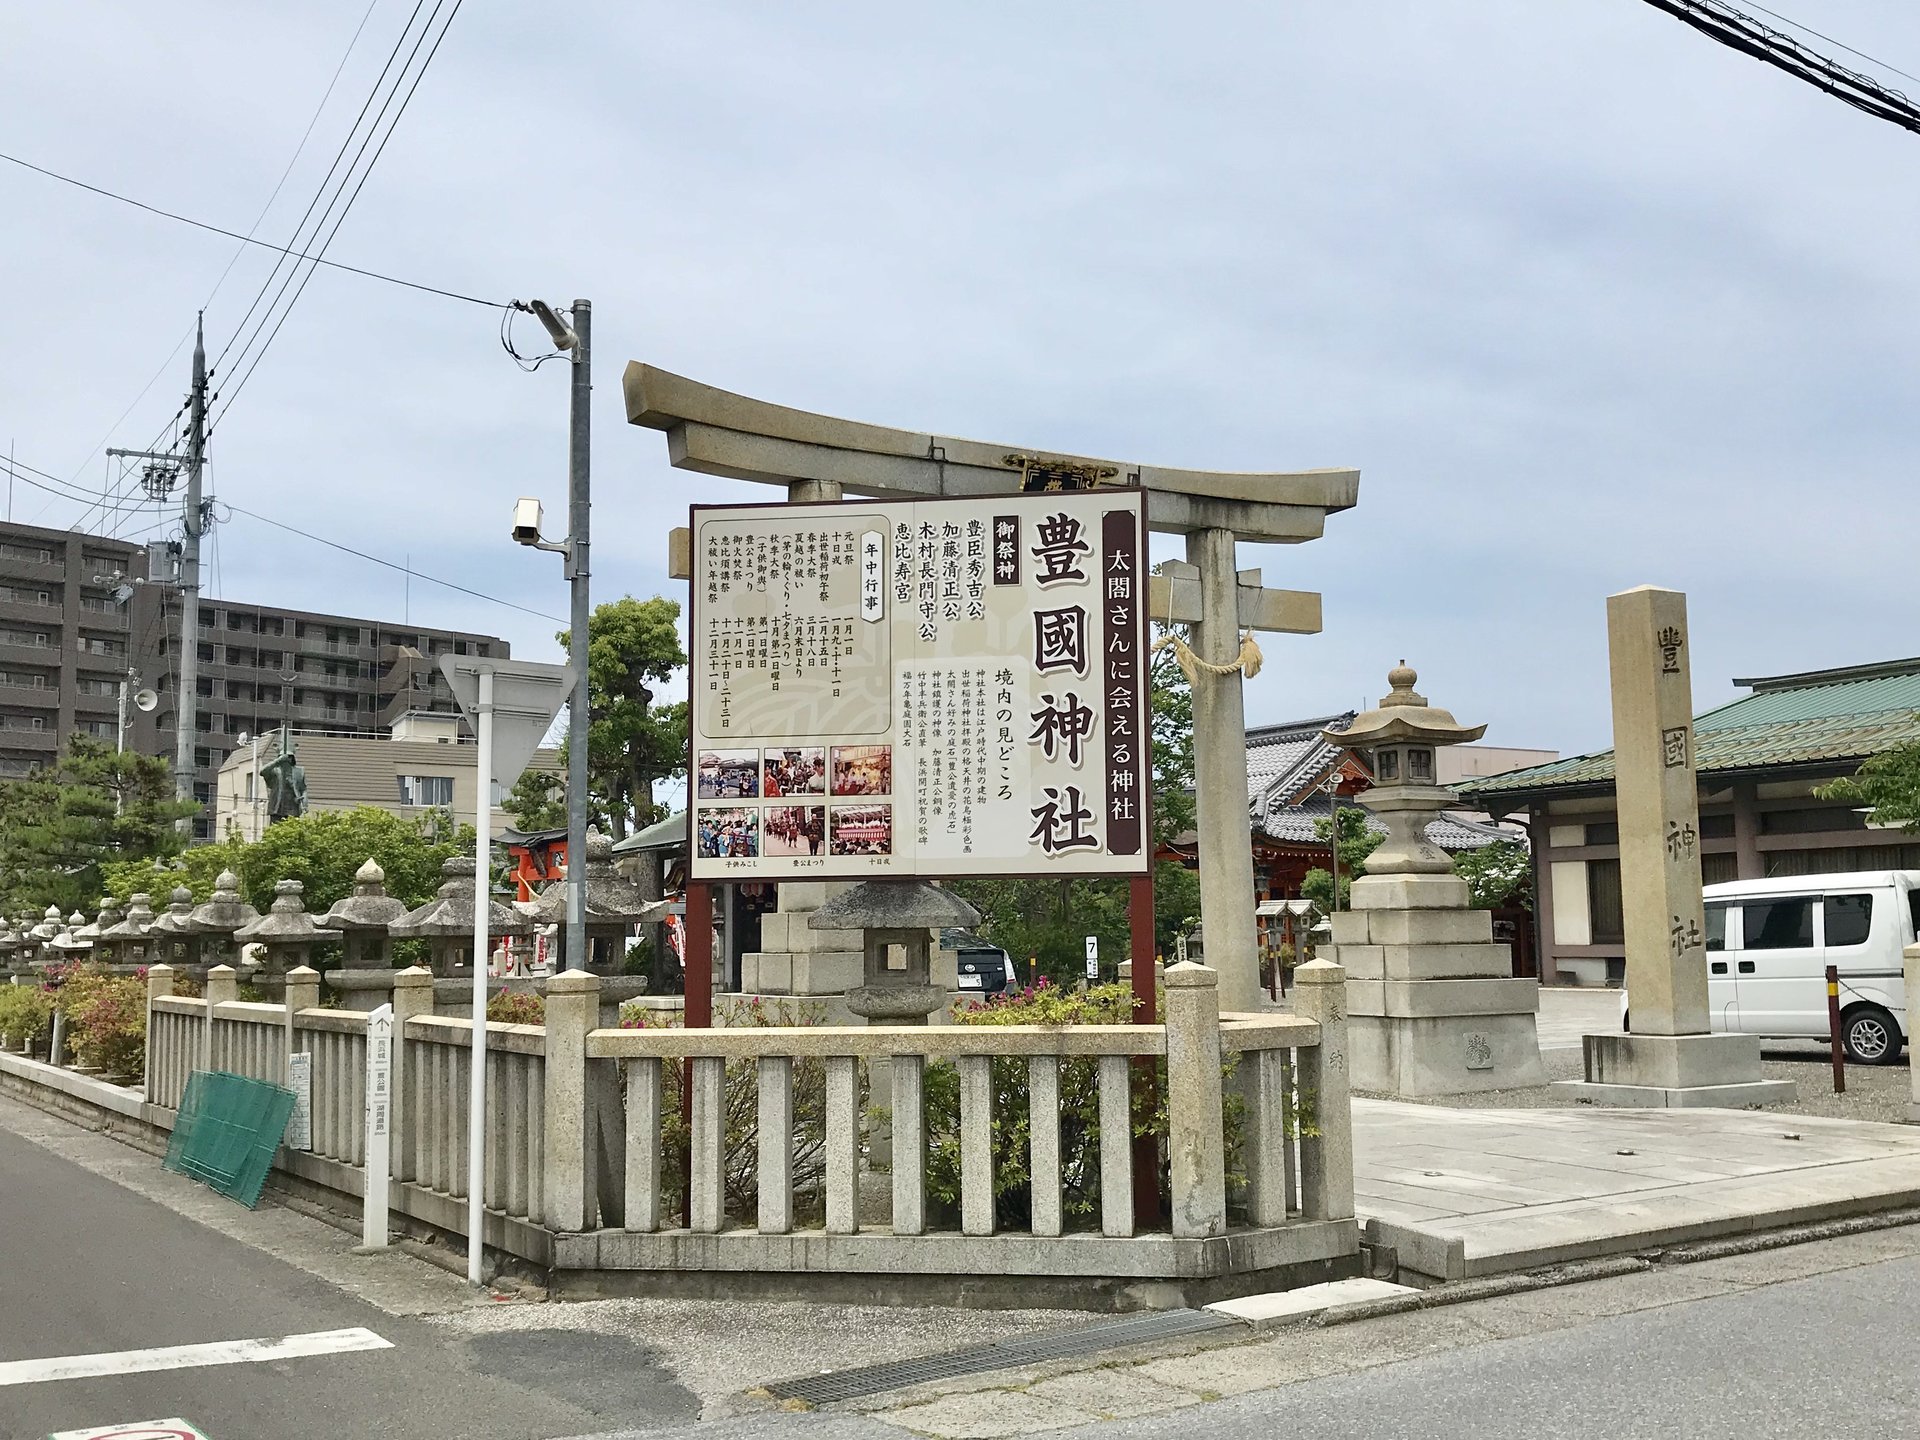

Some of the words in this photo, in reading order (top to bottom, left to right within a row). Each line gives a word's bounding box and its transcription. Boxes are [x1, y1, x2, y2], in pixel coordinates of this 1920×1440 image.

[732, 534, 743, 581] 御火焚祭
[744, 534, 755, 592] 豊公まつり
[769, 533, 780, 580] 秋季大祭
[806, 531, 818, 579] 春季大祭
[831, 531, 843, 566] 十日戎
[843, 530, 855, 566] 元旦祭
[893, 522, 913, 603] 恵比寿宮
[941, 520, 961, 620] 加藤清正公
[965, 518, 984, 618] 豊臣秀吉公
[995, 520, 1016, 580] 御祭神
[863, 542, 879, 611] 年中行事
[916, 520, 936, 639] 木村長門守公
[708, 617, 720, 691] 十二月三十一日
[733, 616, 745, 669] 十一月一日
[745, 616, 757, 669] 第二日曜日
[757, 616, 769, 669] 第一日曜日
[770, 615, 782, 692] 十月第二日曜日
[793, 616, 805, 679] 六月末日より
[806, 615, 817, 667] 三月十八日
[818, 615, 830, 667] 二月十五日
[843, 616, 855, 656] 一月一日
[1027, 512, 1098, 853] 豊國神社
[994, 667, 1015, 801] 境内の見どころ
[724, 860, 758, 869] 子供みこし
[1087, 942, 1096, 953] 7
